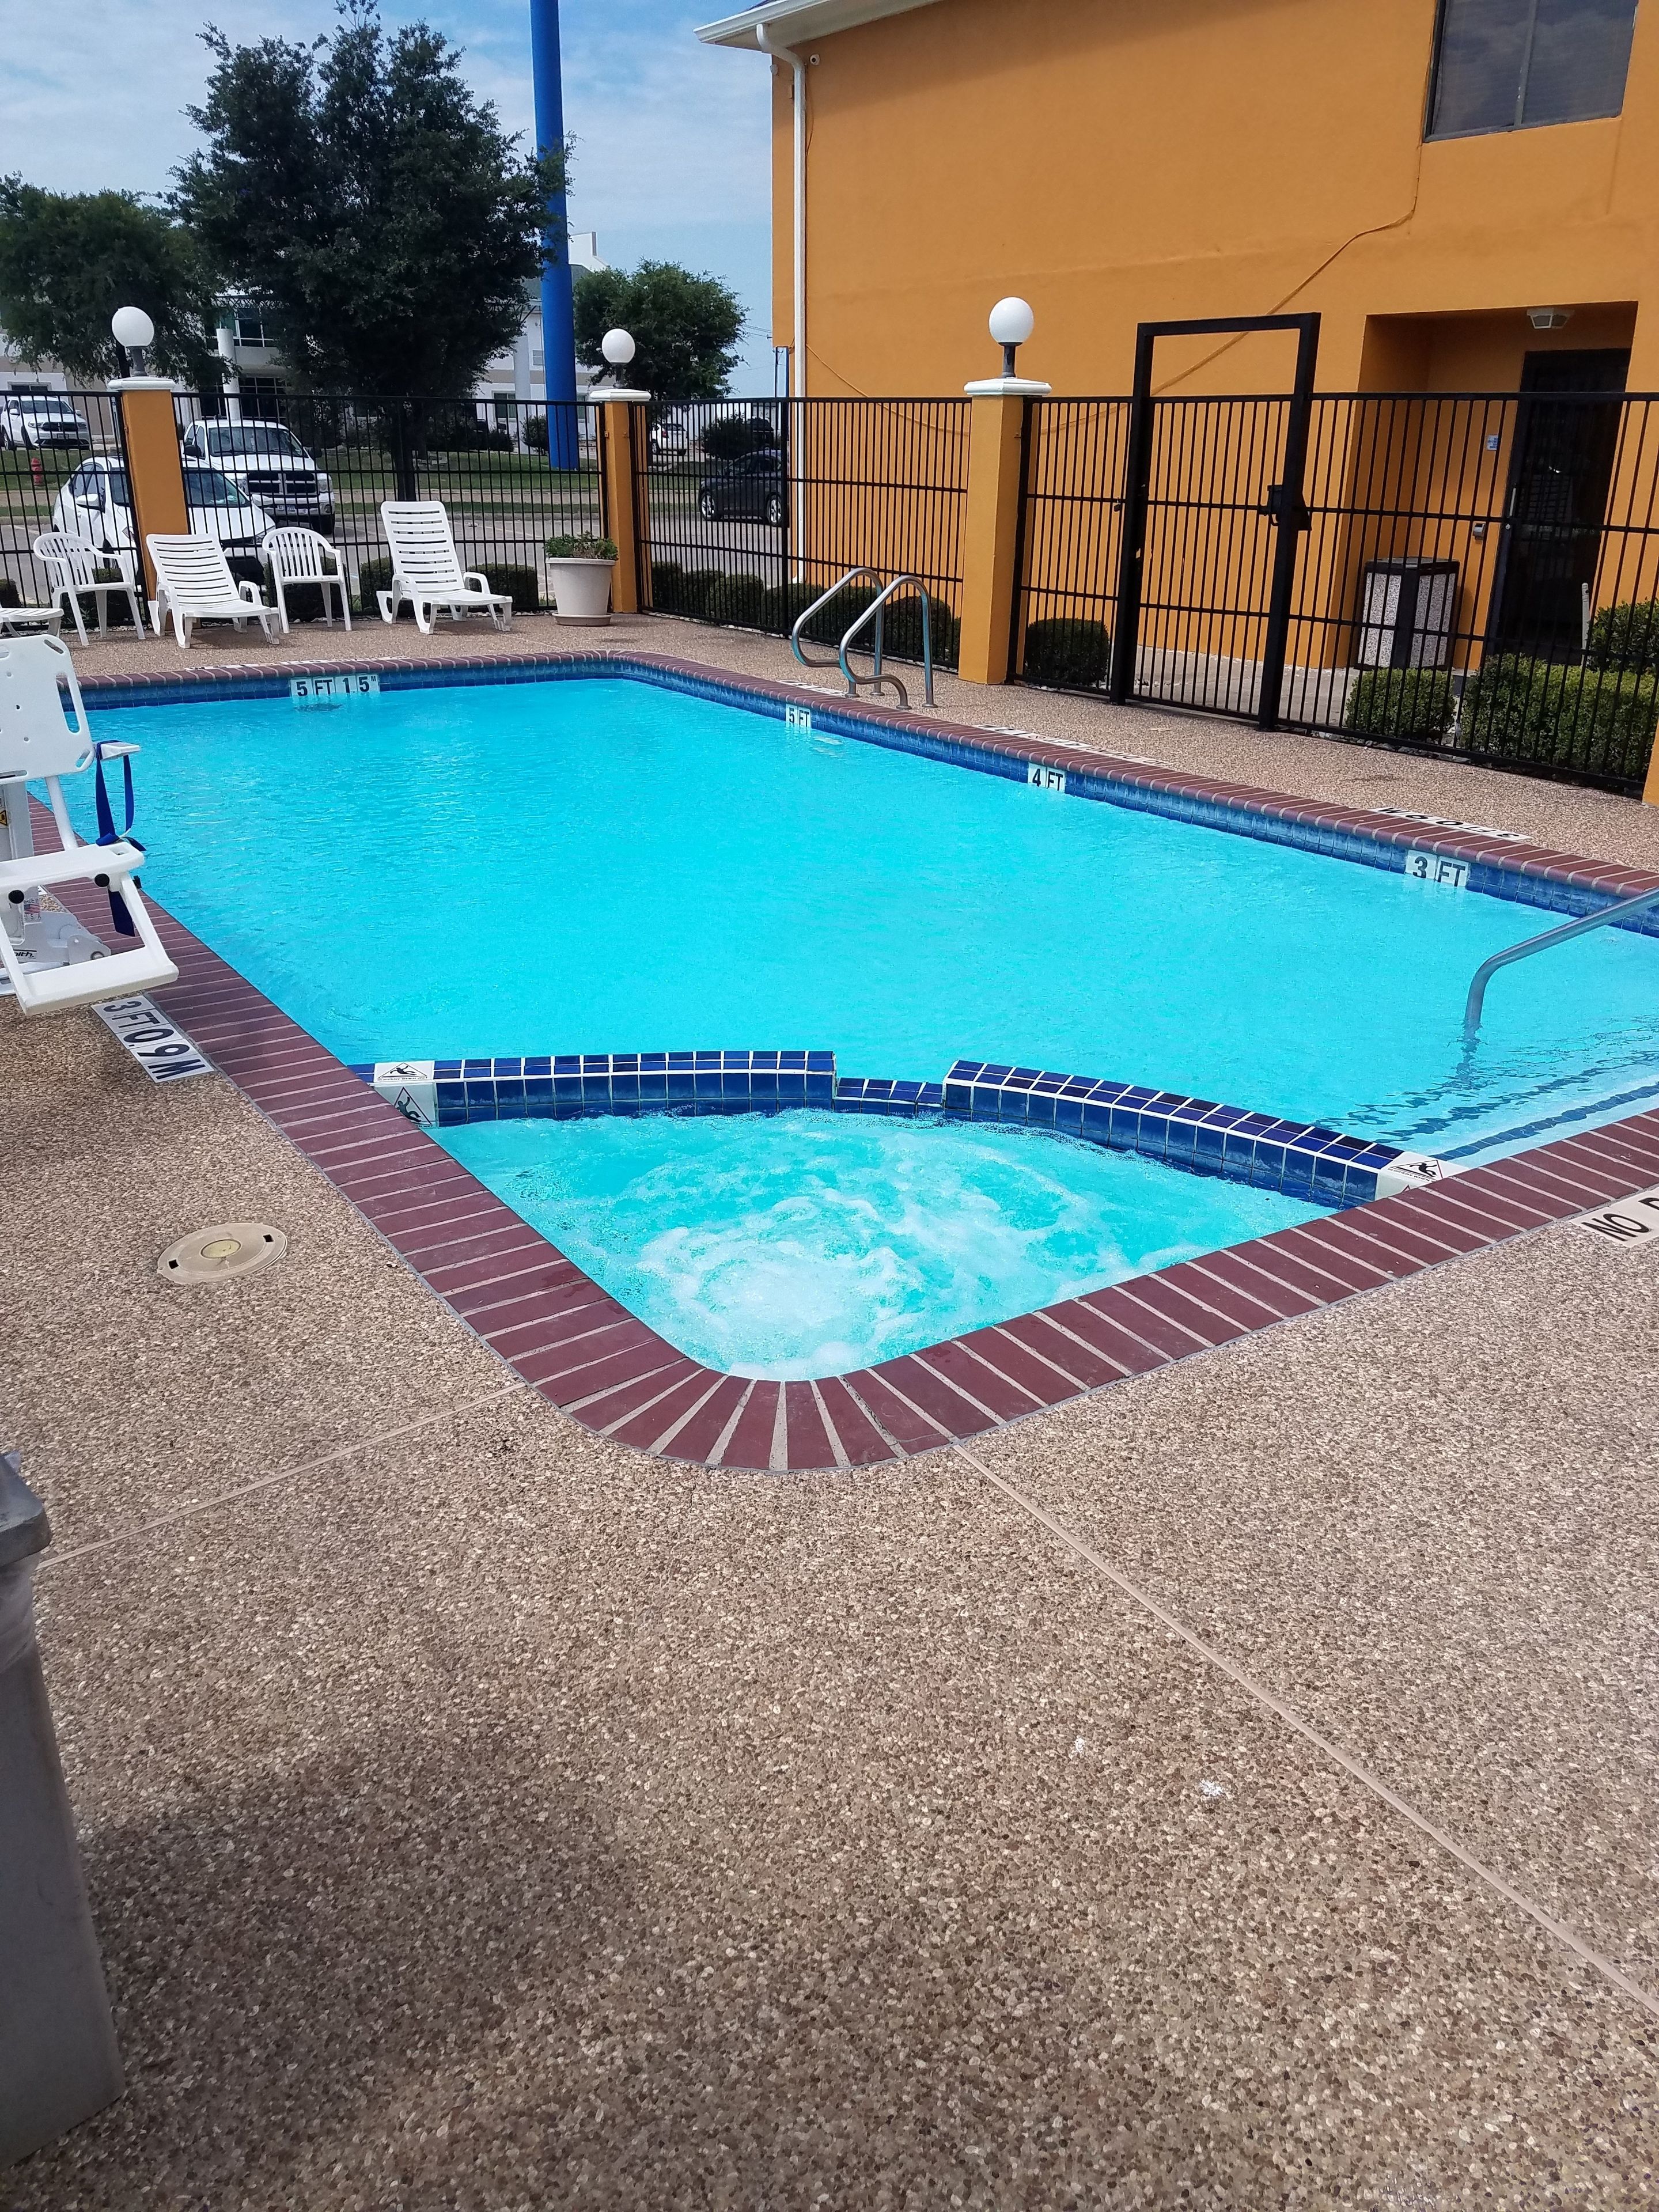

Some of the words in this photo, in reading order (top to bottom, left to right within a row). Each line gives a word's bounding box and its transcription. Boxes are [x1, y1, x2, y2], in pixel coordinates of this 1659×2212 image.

[296, 681, 308, 697] 5
[314, 679, 333, 696] FT
[789, 707, 795, 724] 5
[799, 709, 810, 728] FT
[1032, 768, 1041, 787] 4
[1046, 771, 1064, 791] FT
[1412, 855, 1429, 879] 3
[1437, 860, 1467, 888] FT
[103, 1000, 142, 1013] 3
[111, 1011, 161, 1029] FT
[147, 1058, 206, 1081] M
[1581, 1213, 1649, 1242] NO
